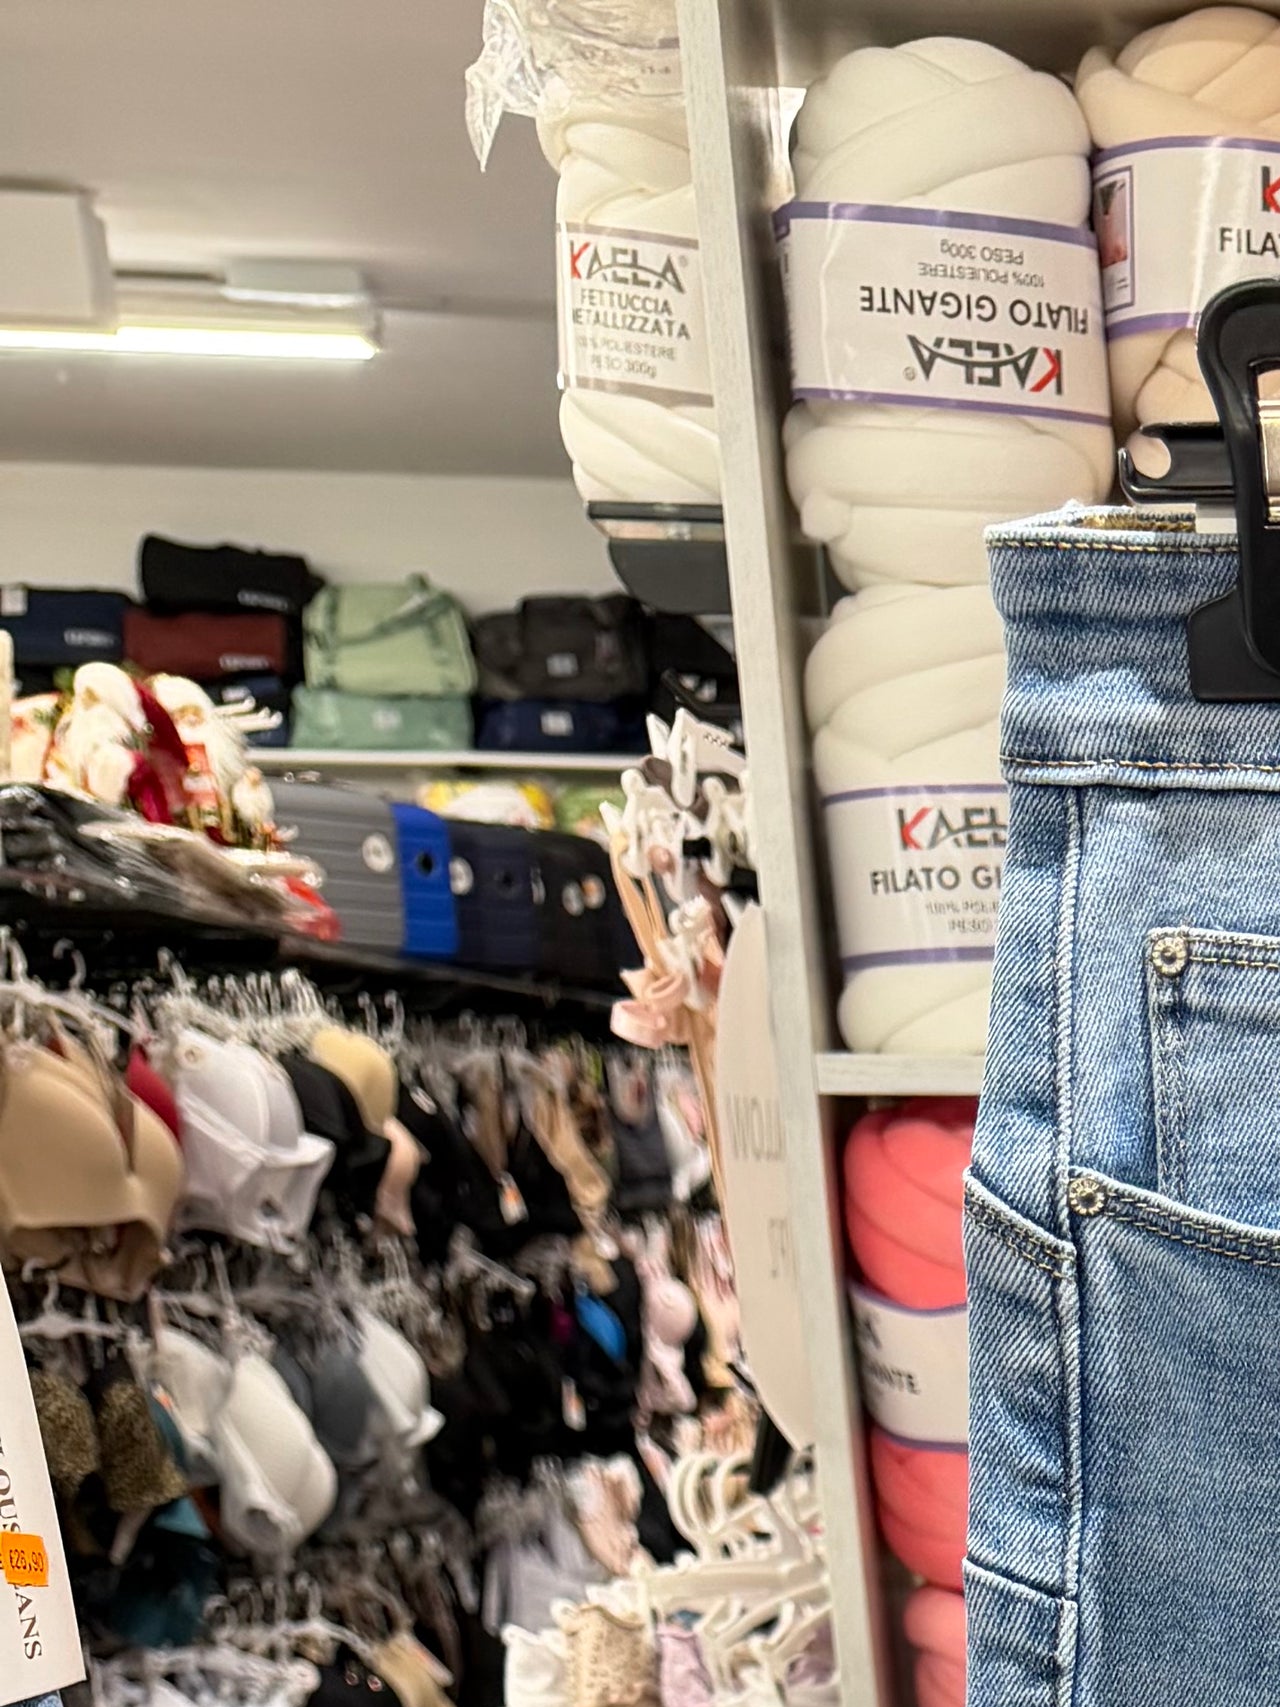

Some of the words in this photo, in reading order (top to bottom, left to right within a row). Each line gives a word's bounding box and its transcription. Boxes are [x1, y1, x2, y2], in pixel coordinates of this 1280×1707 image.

[939, 239, 977, 260] 300g
[981, 246, 1024, 266] PESO
[570, 240, 686, 295] KAELA
[917, 261, 1009, 285] POLIESTERE
[581, 288, 673, 316] FETTUCCIA
[860, 285, 998, 323] GIGANTE
[1009, 299, 1089, 334] FILATO
[906, 334, 1063, 396] KAELA
[869, 865, 961, 896] FILATO
